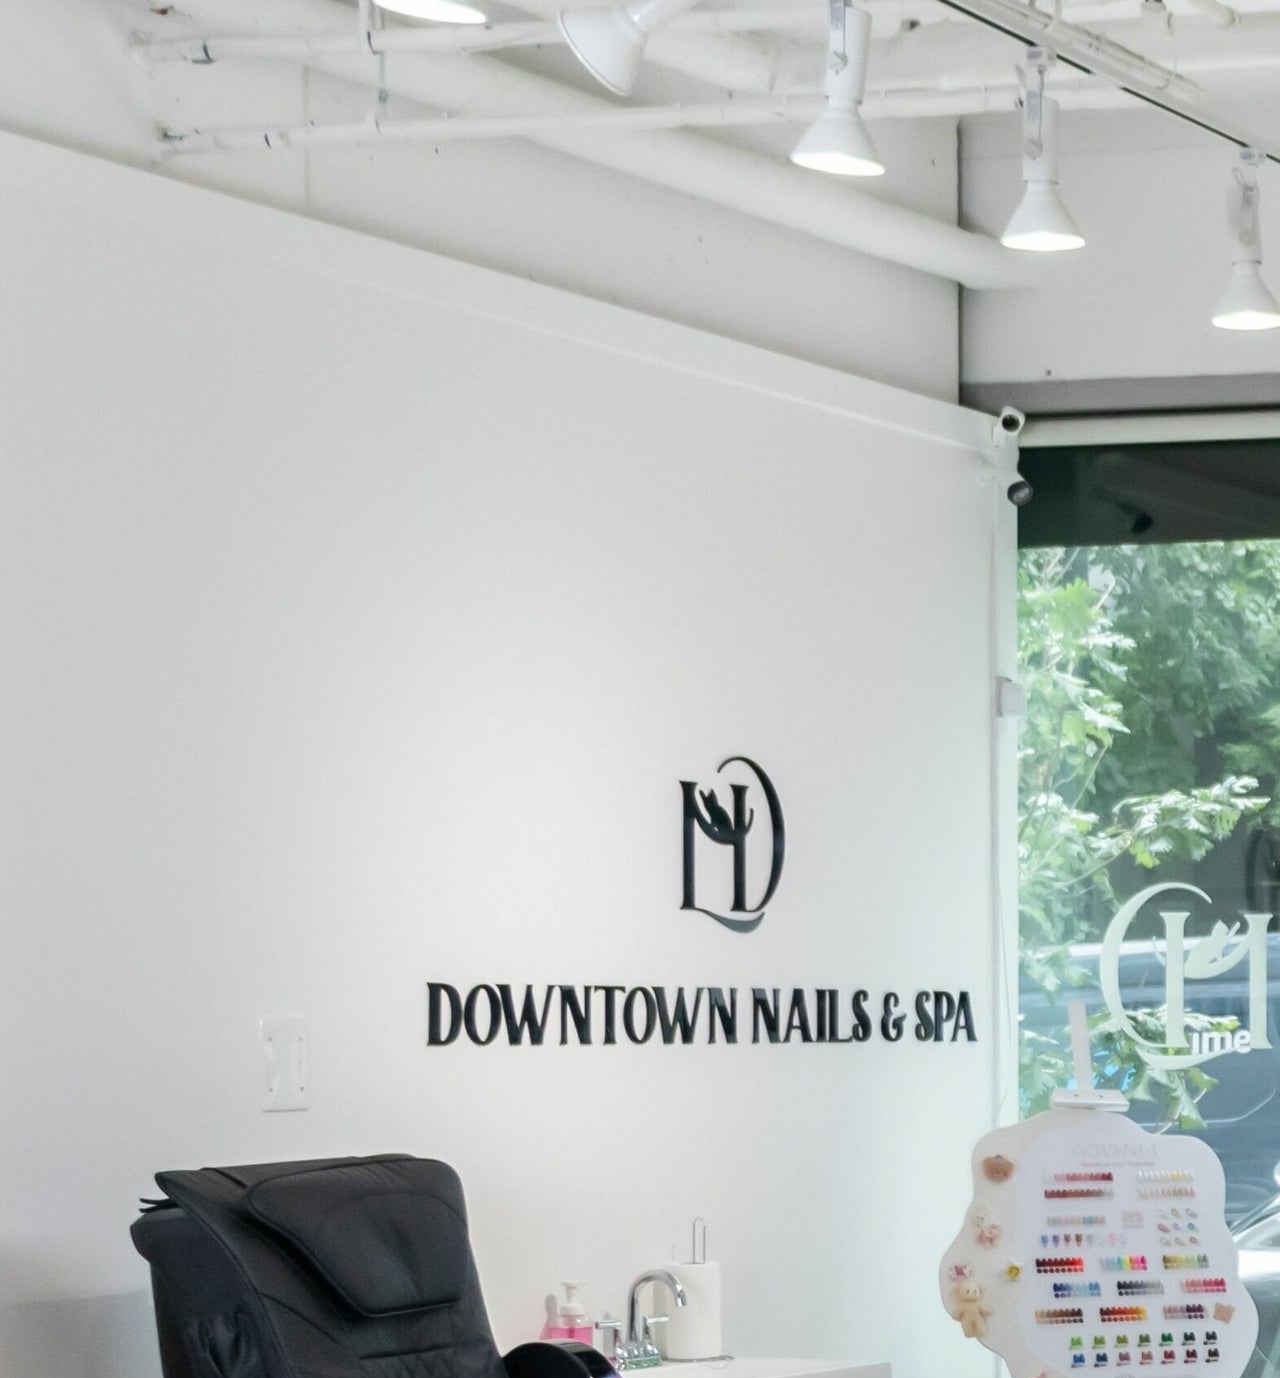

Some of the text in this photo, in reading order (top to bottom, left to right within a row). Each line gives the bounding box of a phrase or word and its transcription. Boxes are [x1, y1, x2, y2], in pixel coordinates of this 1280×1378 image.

[425, 981, 979, 1047] DOWNTOWN NAILS & SPA
[1190, 1029, 1252, 1054] ime
